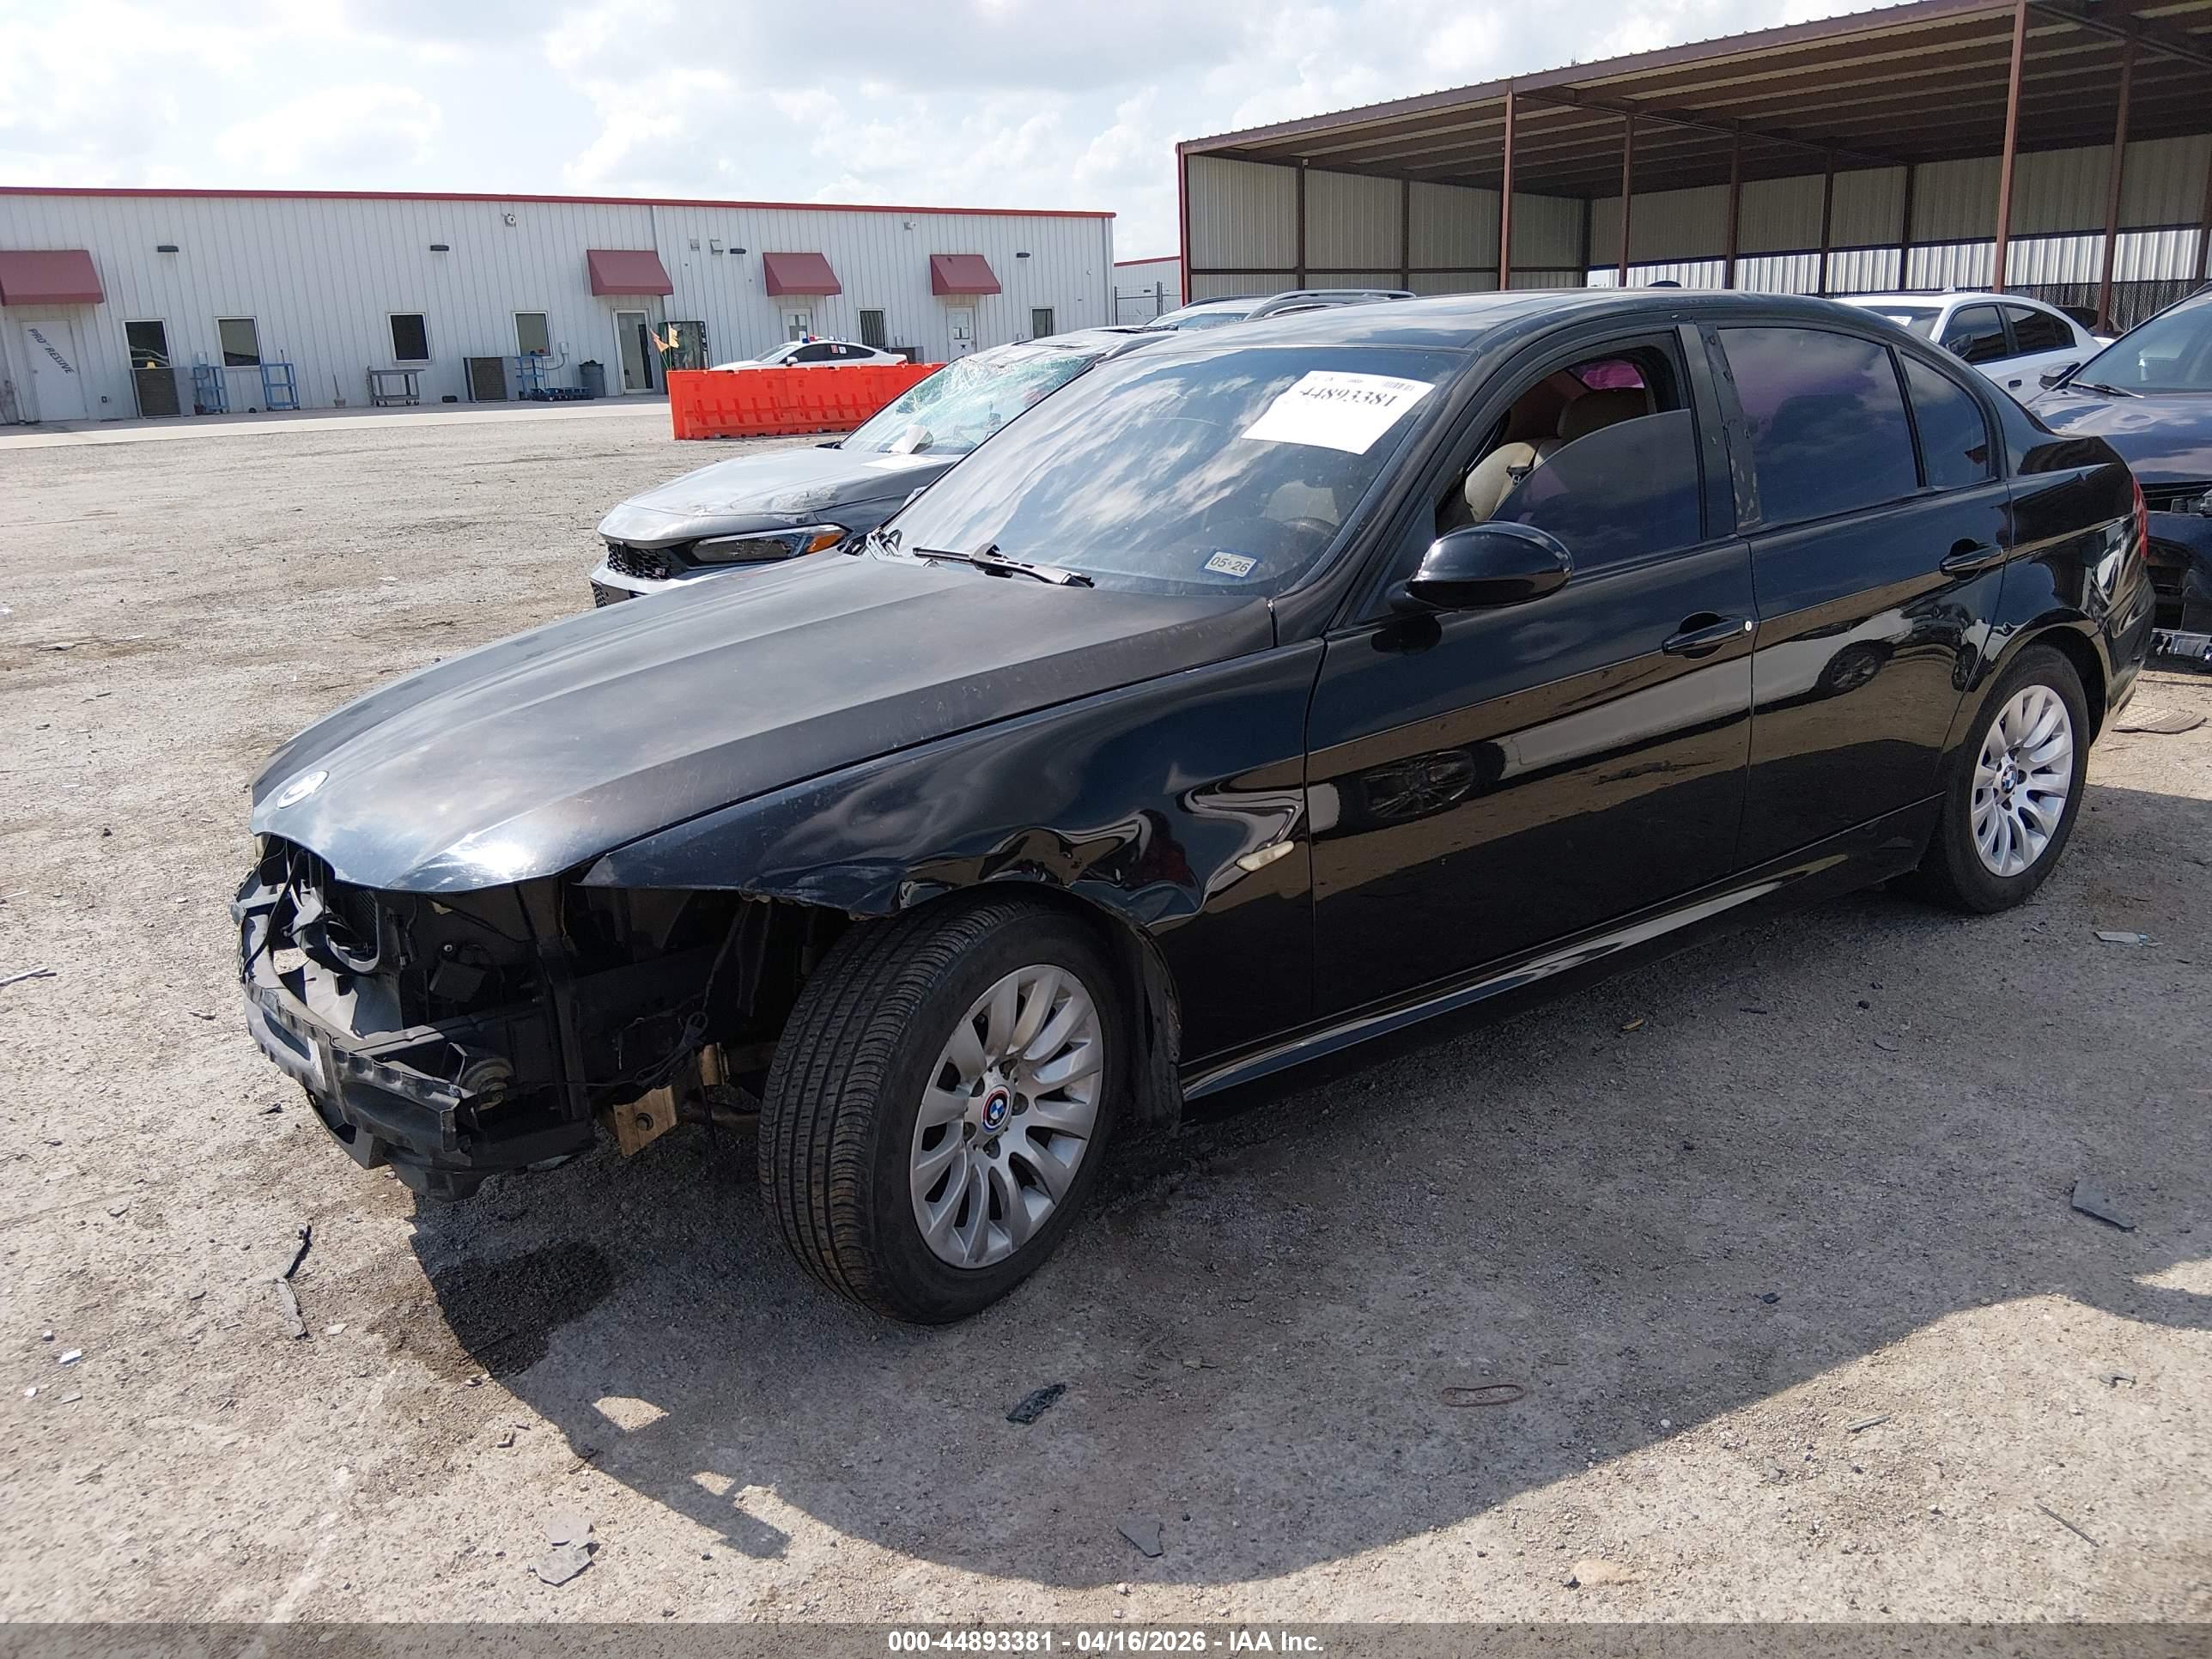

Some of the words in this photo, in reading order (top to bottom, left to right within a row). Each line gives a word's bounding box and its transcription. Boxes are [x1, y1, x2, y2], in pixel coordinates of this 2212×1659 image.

[1299, 387, 1399, 407] 44893381
[1211, 556, 1231, 568] 05
[1230, 561, 1250, 573] 26
